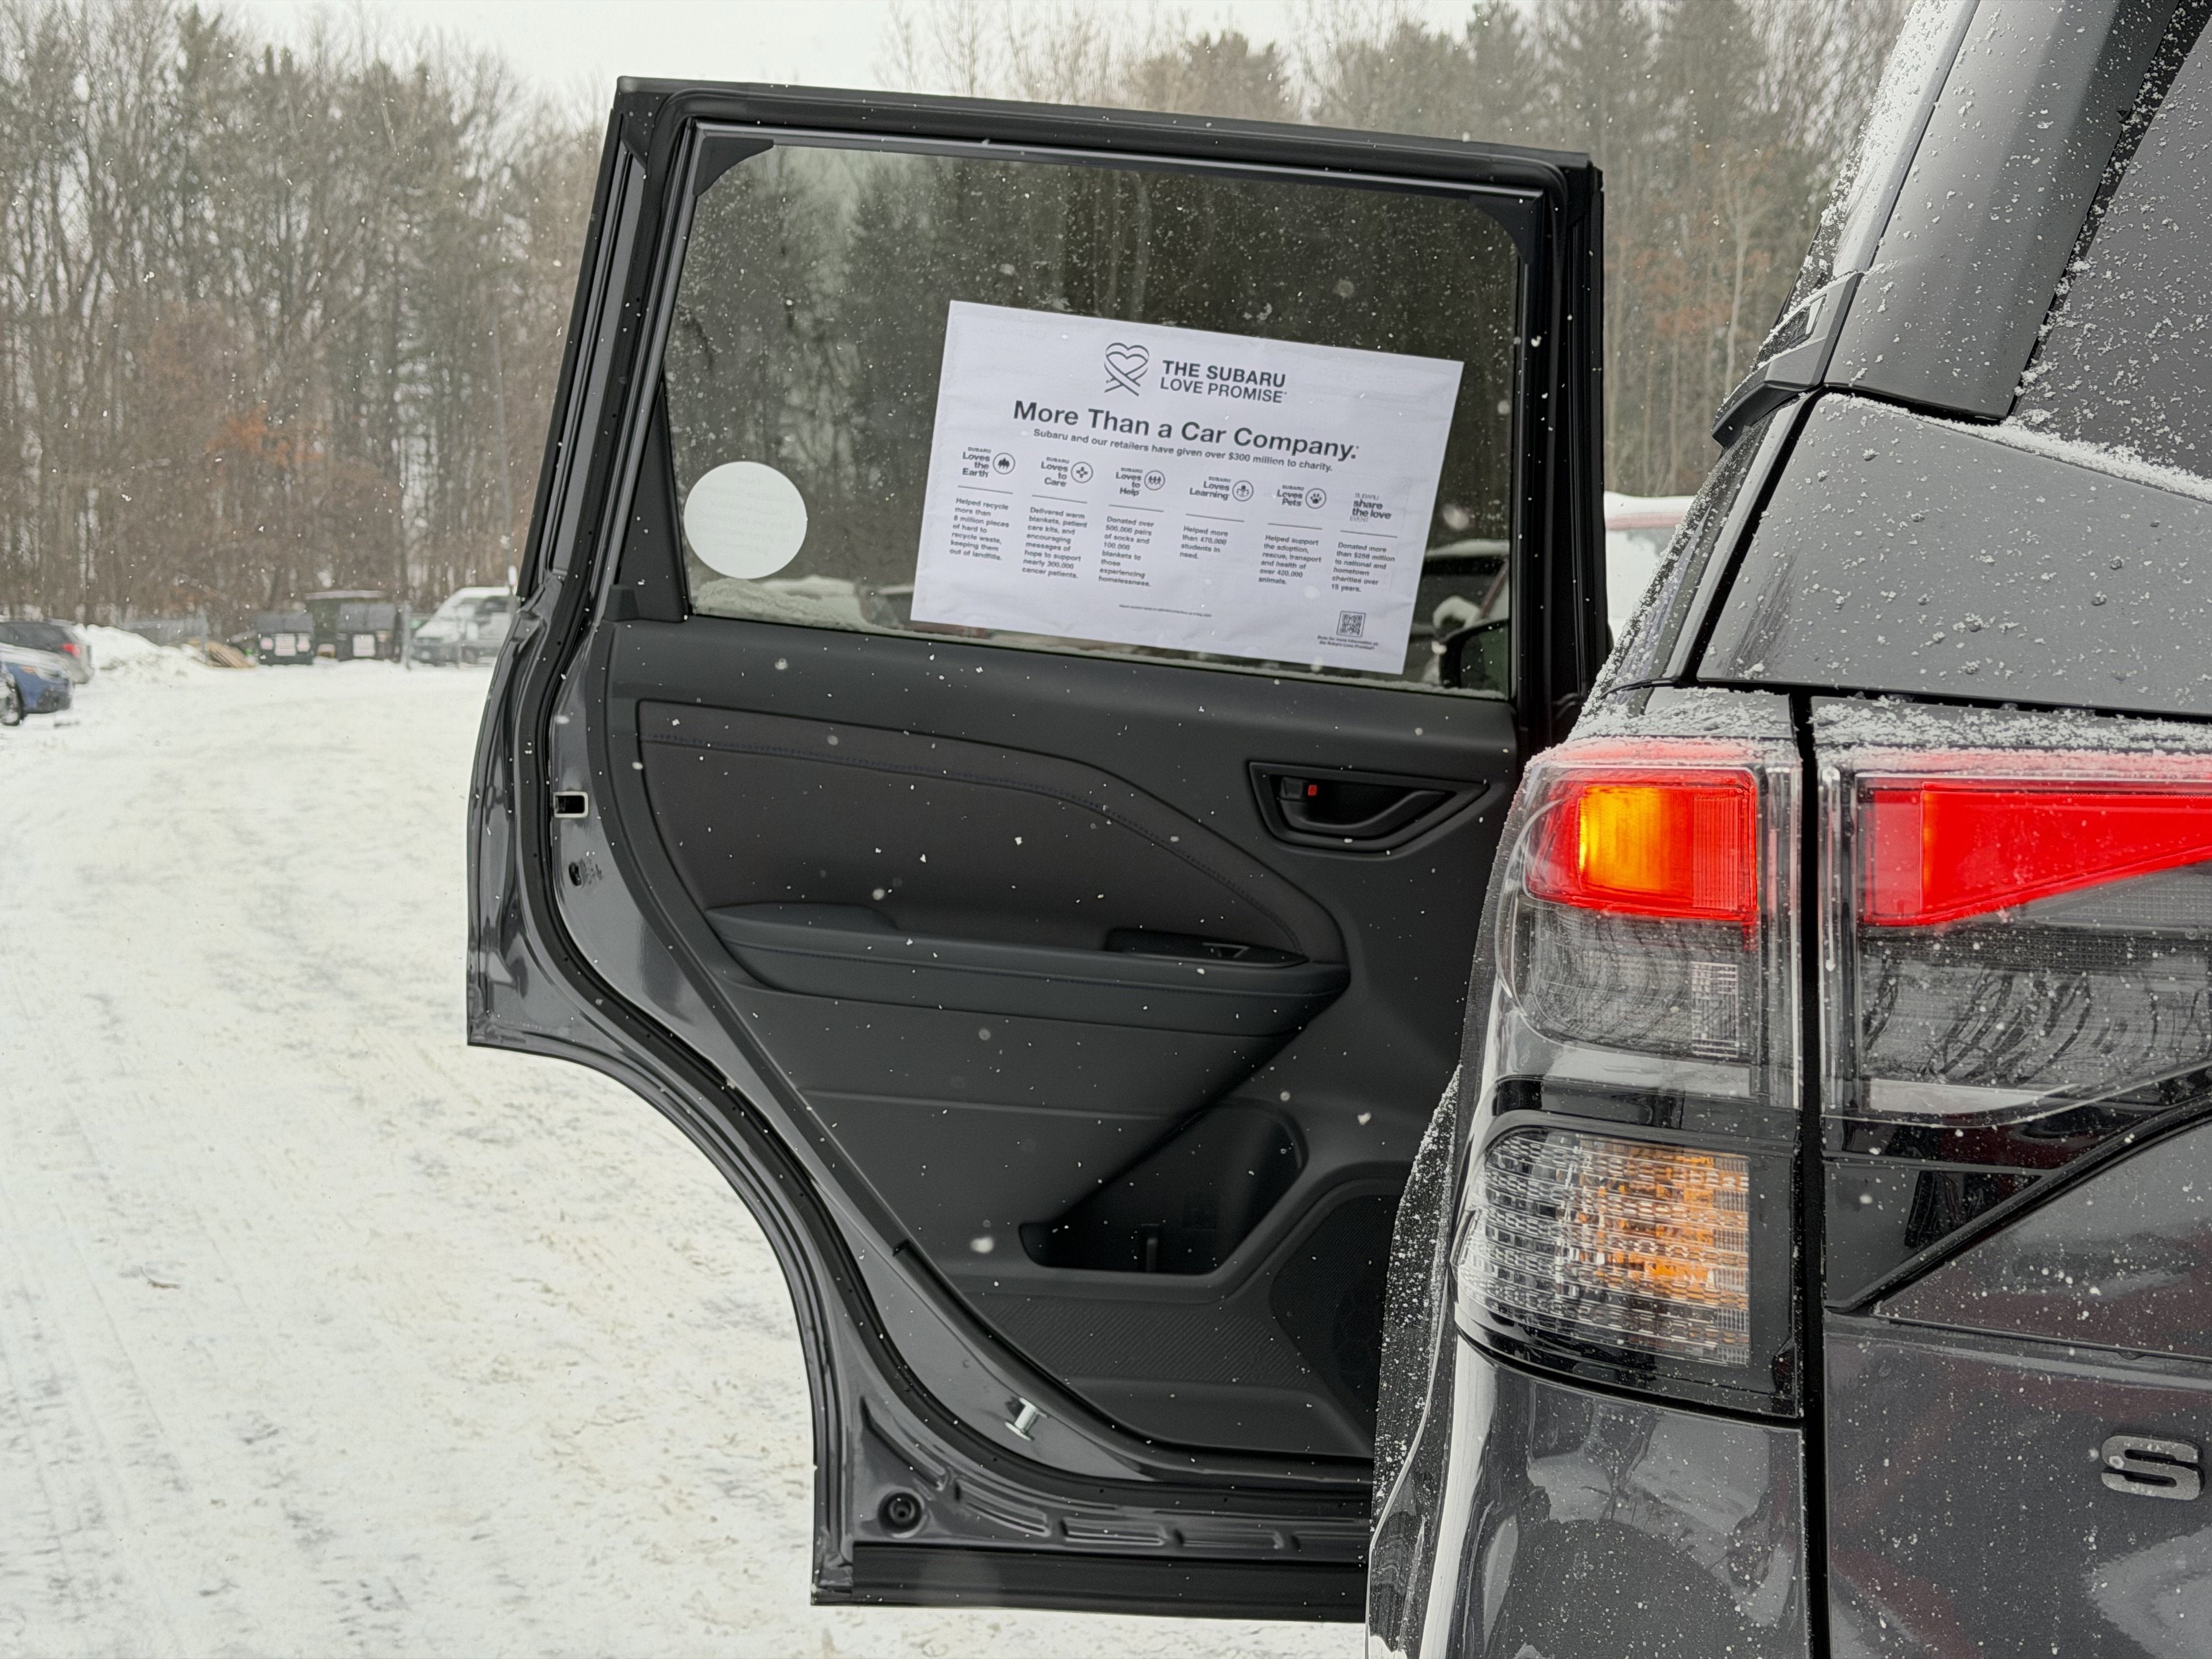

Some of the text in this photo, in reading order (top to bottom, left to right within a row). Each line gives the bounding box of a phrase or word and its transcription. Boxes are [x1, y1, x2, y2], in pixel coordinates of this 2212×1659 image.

[1163, 360, 1286, 388] THE SUBARU
[1160, 376, 1283, 403] LOVE PROMISE
[1013, 400, 1079, 426] More
[1088, 408, 1149, 436] Than
[1158, 424, 1172, 438] a
[1181, 421, 1227, 444] Car
[1033, 428, 1333, 473] Subaru and our retailers have given over $300 million to charity.
[962, 452, 990, 462] Loves
[974, 461, 990, 470] the
[1041, 461, 1068, 472] Loves
[962, 467, 989, 478] Earth
[1058, 472, 1068, 480] to
[1115, 471, 1142, 481] Loves
[1044, 477, 1067, 487] Care
[1203, 481, 1230, 492] Loves
[1119, 487, 1139, 497] Help
[1189, 487, 1229, 501] Learning
[1277, 489, 1303, 499] Loves
[1282, 498, 1302, 507] Pets
[1353, 499, 1383, 510] share
[1352, 507, 1392, 520] the love
[2101, 1435, 2201, 1501] S
